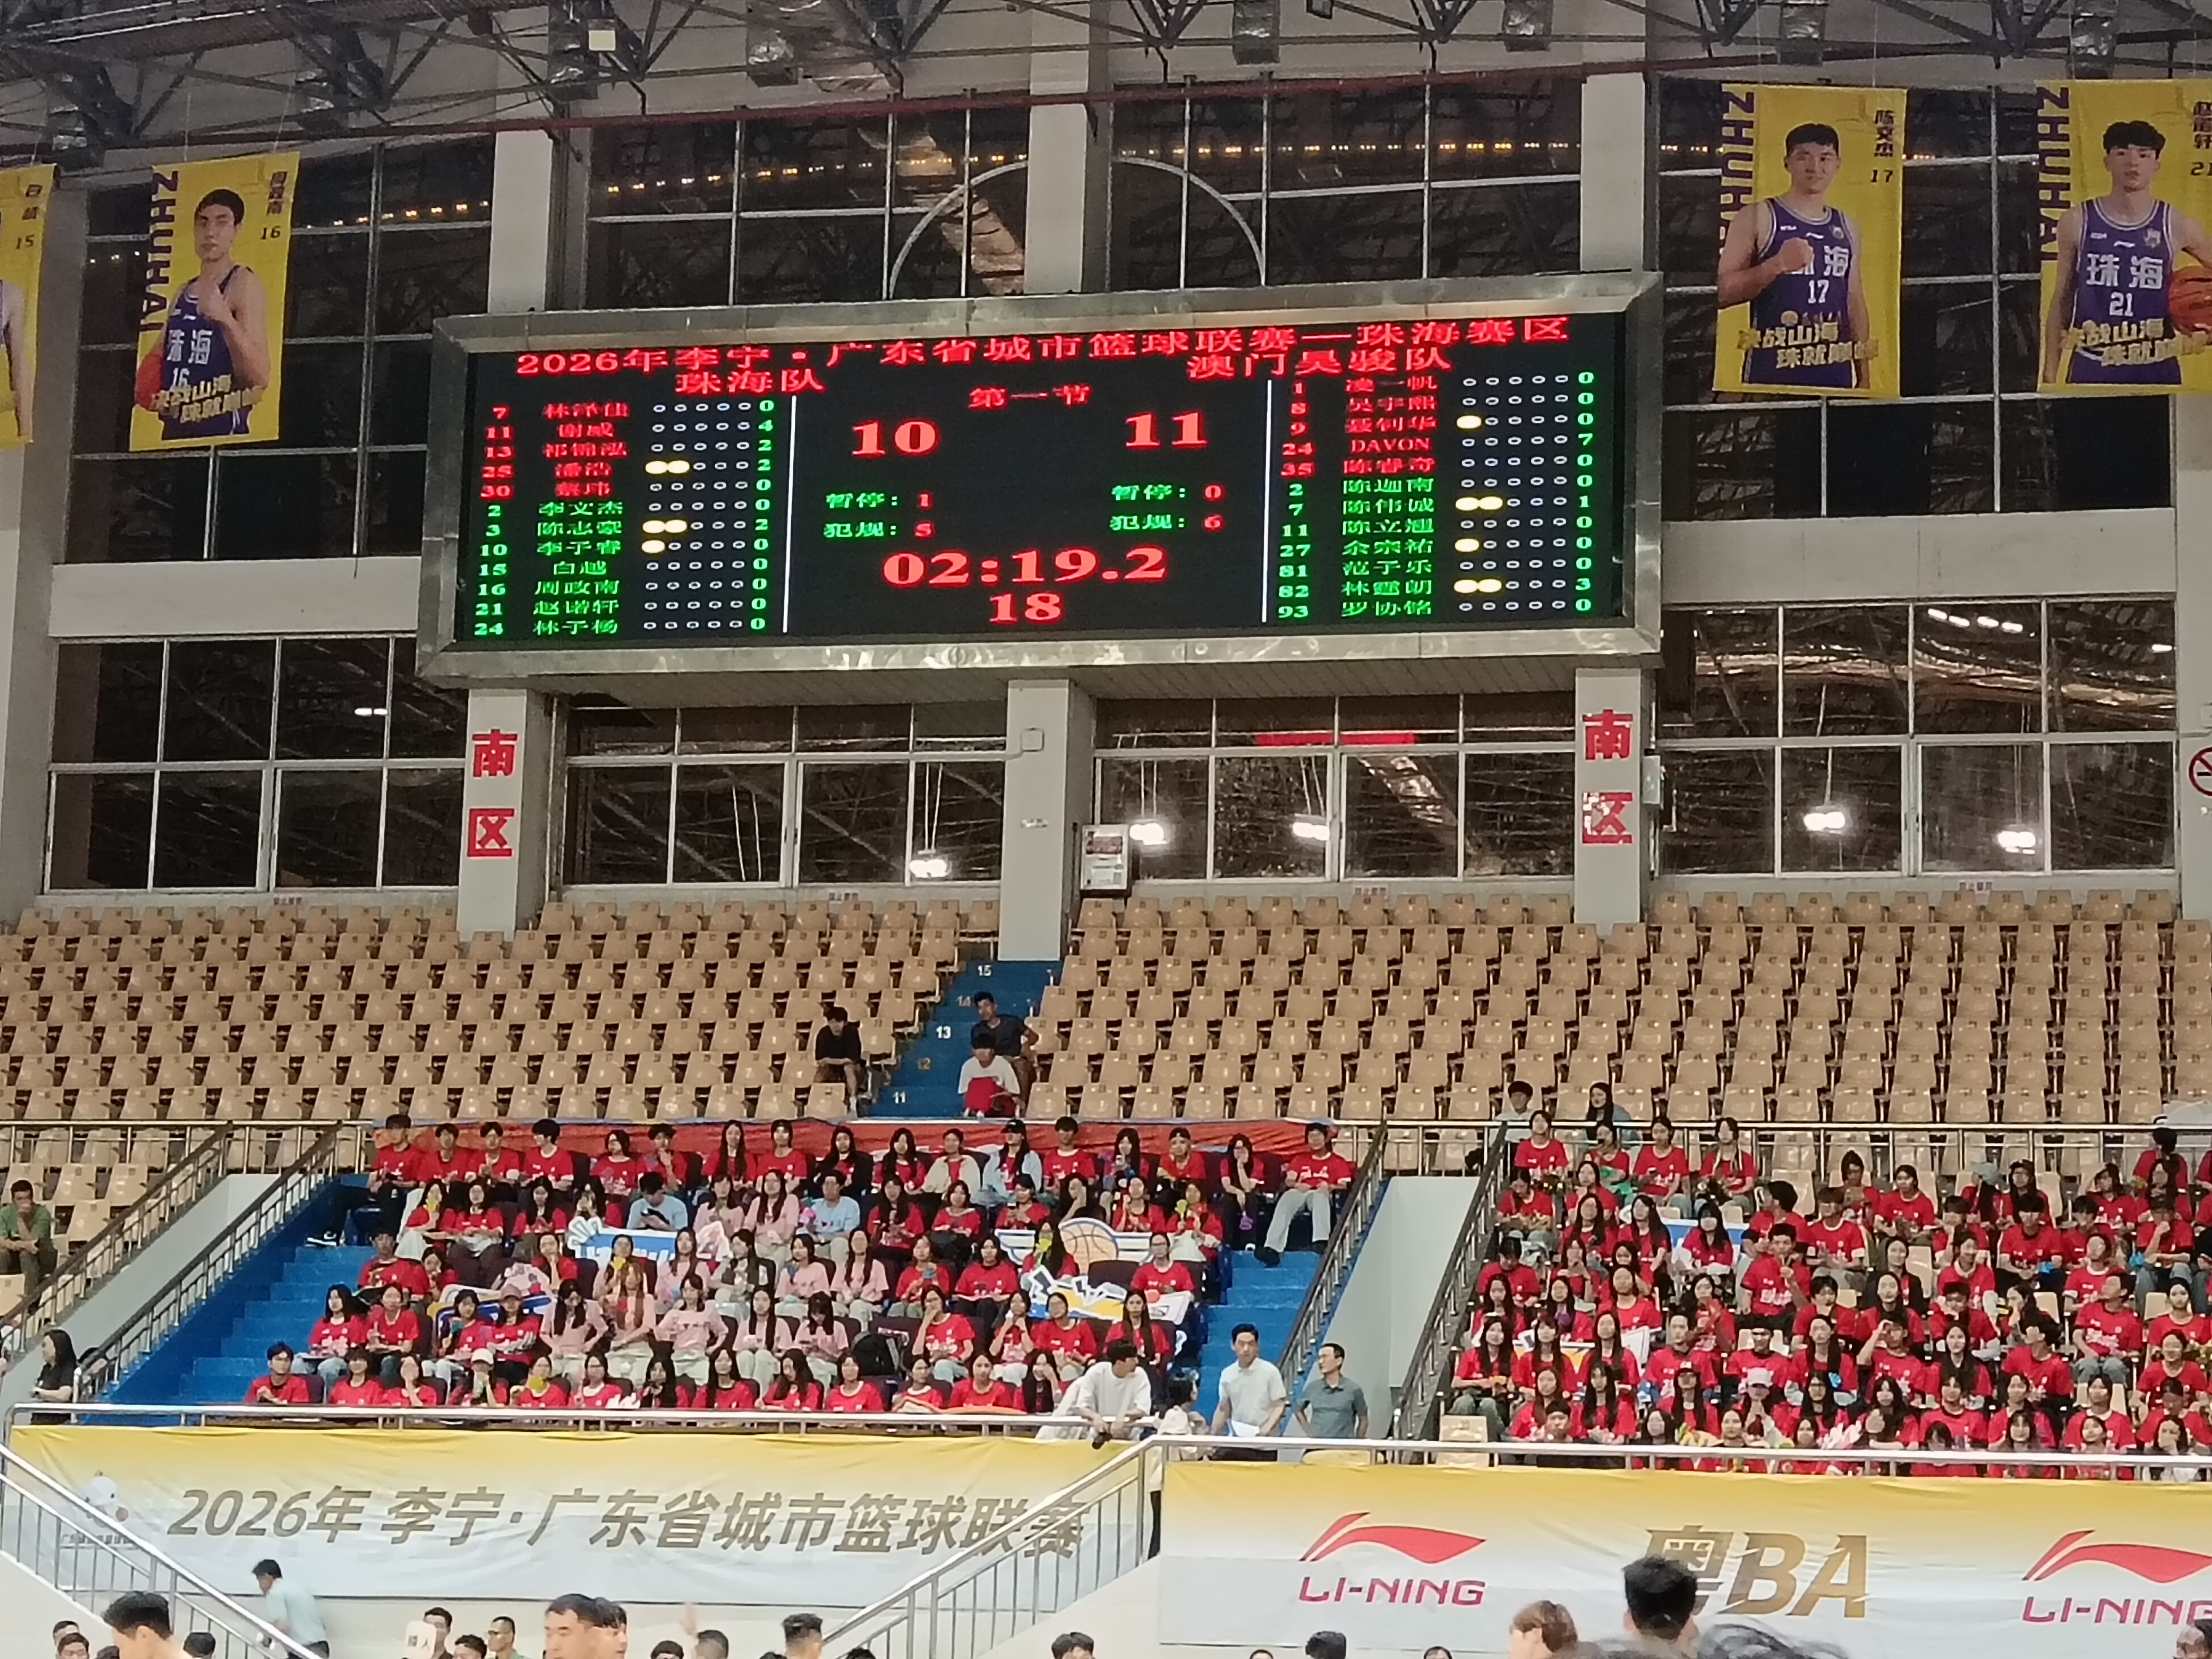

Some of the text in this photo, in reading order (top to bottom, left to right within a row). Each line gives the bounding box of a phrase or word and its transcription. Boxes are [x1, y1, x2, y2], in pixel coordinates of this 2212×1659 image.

[1871, 170, 1893, 182] 17
[2037, 87, 2071, 261] ZHUHAI
[261, 225, 281, 239] 16
[16, 233, 35, 249] 15
[1784, 246, 1849, 278] 海
[2086, 253, 2163, 289] 珠海
[1808, 279, 1829, 304] 17
[2109, 293, 2134, 317] 21
[674, 370, 826, 394] 珠海队
[1578, 372, 1594, 384] 0
[969, 385, 1091, 409] 第一节
[1578, 392, 1594, 405] 0
[759, 400, 775, 412] 0
[1577, 412, 1594, 425] 0
[758, 419, 773, 432] 4
[1125, 412, 1208, 447] 11
[851, 420, 939, 455] 10
[1578, 433, 1593, 446] 7
[758, 439, 772, 451] 2
[1351, 438, 1429, 453] DAVON
[757, 458, 771, 471] 2
[1577, 454, 1593, 467] 0
[756, 479, 771, 491] 0
[1577, 474, 1593, 487] 0
[1112, 484, 1223, 501] 暂停： 0
[1289, 483, 1303, 496] 2
[755, 498, 770, 511] 0
[826, 492, 933, 509] 暂停： 1
[1343, 497, 1434, 515] 陈伟诚
[1579, 495, 1590, 508] 1
[488, 505, 501, 517] 2
[539, 501, 623, 517] 李文杰
[1288, 503, 1303, 516] 7
[755, 518, 769, 531] 2
[1110, 514, 1222, 531] 犯规： 6
[1576, 516, 1593, 529] 0
[486, 524, 500, 537] 3
[823, 522, 897, 538] 犯规：
[1282, 524, 1308, 537] 11
[754, 538, 769, 550] 0
[1576, 536, 1592, 549] 0
[480, 544, 508, 556] 10
[1280, 544, 1311, 557] 27
[479, 563, 507, 576] 15
[553, 560, 607, 576] 白越
[753, 558, 768, 571] 0
[882, 547, 1167, 586] 02:19.2
[1575, 557, 1592, 570] 0
[1279, 564, 1308, 578] 81
[478, 583, 506, 596] 16
[752, 578, 767, 590] 0
[1575, 577, 1591, 591] 3
[1278, 585, 1309, 598] 82
[475, 603, 503, 616] 21
[751, 598, 766, 610] 0
[989, 593, 1061, 623] 18
[1575, 598, 1591, 611] 0
[1278, 605, 1309, 618] 93
[474, 623, 504, 635] 24
[750, 617, 765, 630] 0
[1582, 709, 1633, 844] 南区
[467, 729, 517, 857] 南区
[978, 965, 991, 976] 15
[957, 996, 971, 1007] 14
[936, 1026, 951, 1039] 13
[893, 1092, 906, 1104] 11
[167, 1486, 1091, 1558] 2026年 李宁·广东省城市篮球联赛
[1299, 1576, 1486, 1606] LI-NING
